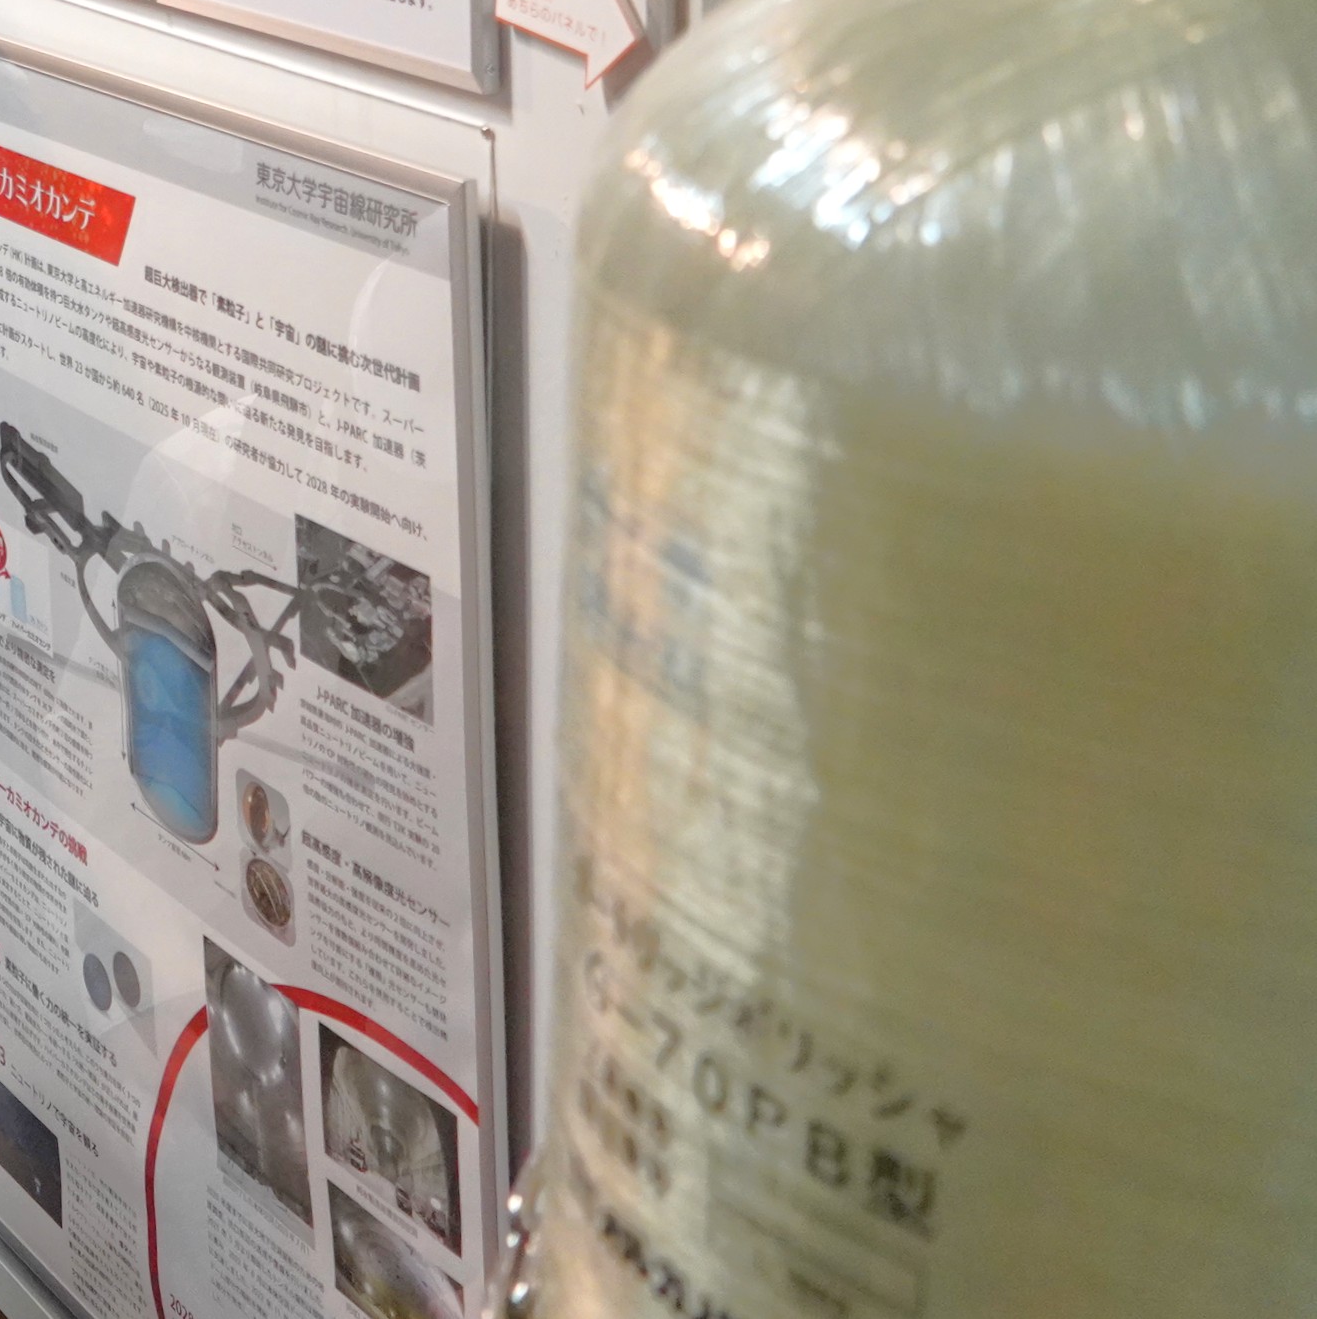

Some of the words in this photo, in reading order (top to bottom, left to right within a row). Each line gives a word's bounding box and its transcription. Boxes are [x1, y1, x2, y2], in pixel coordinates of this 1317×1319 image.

[256, 161, 419, 238] 東京大学宇宙線研究所
